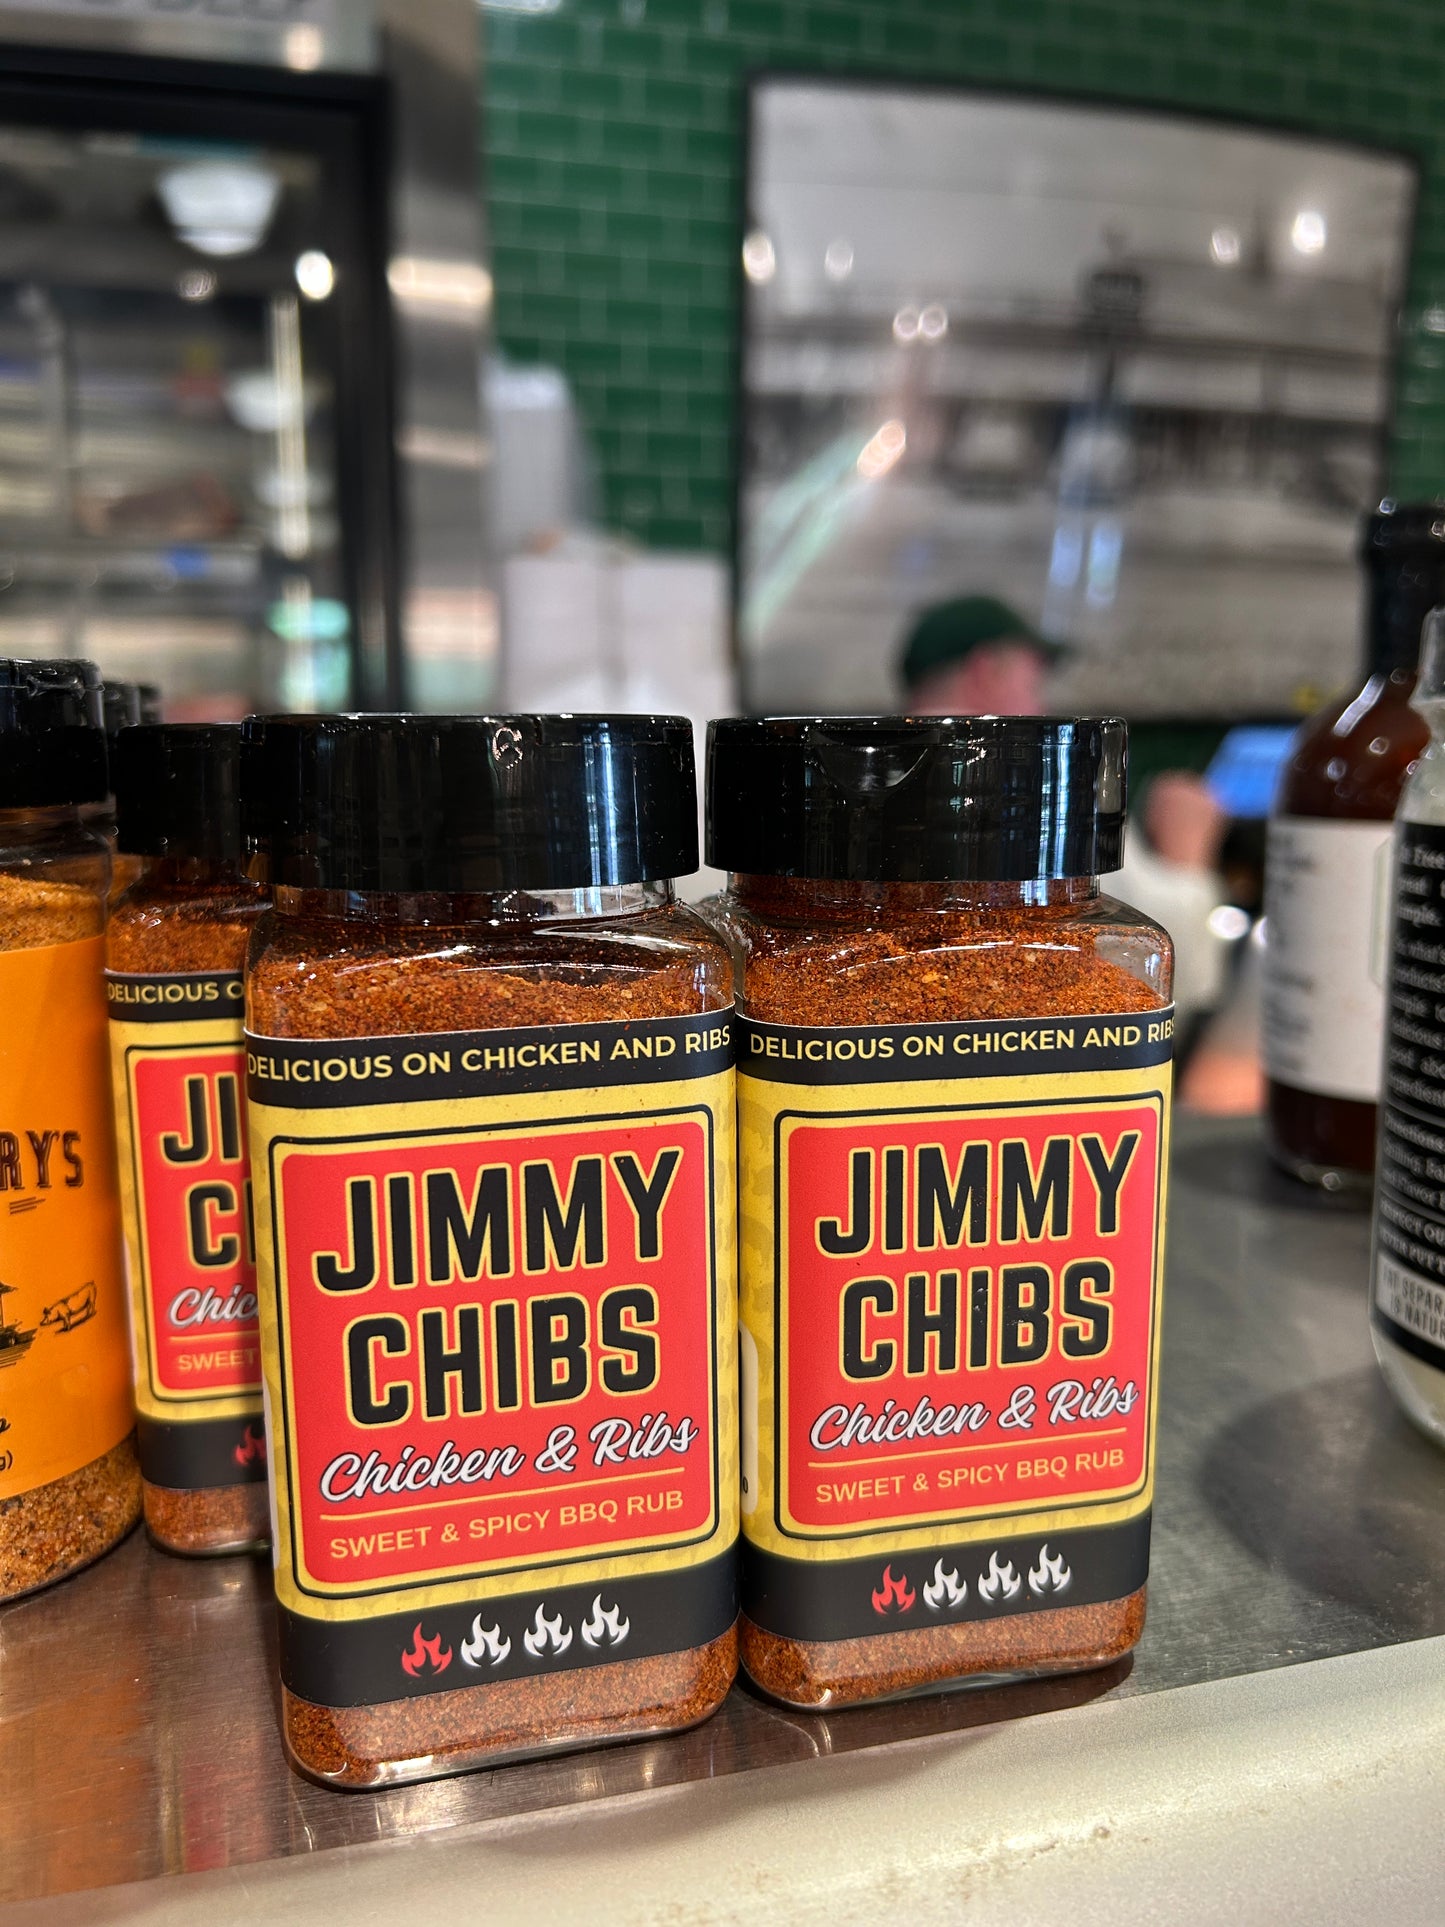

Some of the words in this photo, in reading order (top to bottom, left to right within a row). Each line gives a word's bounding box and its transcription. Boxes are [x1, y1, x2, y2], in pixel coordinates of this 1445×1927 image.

[108, 981, 219, 1004] DELICIOUS
[248, 1055, 393, 1083] DELICIOUS
[402, 1052, 451, 1076] ON
[461, 1040, 600, 1071] CHICKEN
[610, 1035, 676, 1061] AND
[685, 1025, 730, 1054] RIBS
[750, 1034, 895, 1061] DELICIOUS
[902, 1034, 945, 1056] ON
[953, 1029, 1074, 1053] CHICKEN
[1082, 1026, 1141, 1048] AND
[311, 1145, 684, 1296] JIMMY
[814, 1129, 1143, 1260] JIMMY
[343, 1283, 661, 1429] CHIBS
[842, 1257, 1114, 1383] CHIBS
[177, 1347, 256, 1371] SWEET
[809, 1396, 991, 1451] Chicken
[997, 1384, 1037, 1429] &
[1047, 1376, 1140, 1424] Ribs
[319, 1441, 526, 1503] Chicken
[535, 1425, 578, 1474] &
[588, 1411, 699, 1466] Ribs
[816, 1475, 906, 1503] SWEET
[912, 1472, 930, 1491] &
[937, 1462, 1009, 1488] SPICY
[1017, 1455, 1068, 1480] BBQ
[1075, 1448, 1125, 1471] RUB
[330, 1525, 432, 1560] SWEET
[440, 1523, 461, 1543] &
[468, 1509, 551, 1540] SPICY
[559, 1499, 619, 1526] BBQ
[627, 1490, 684, 1515] RUB
